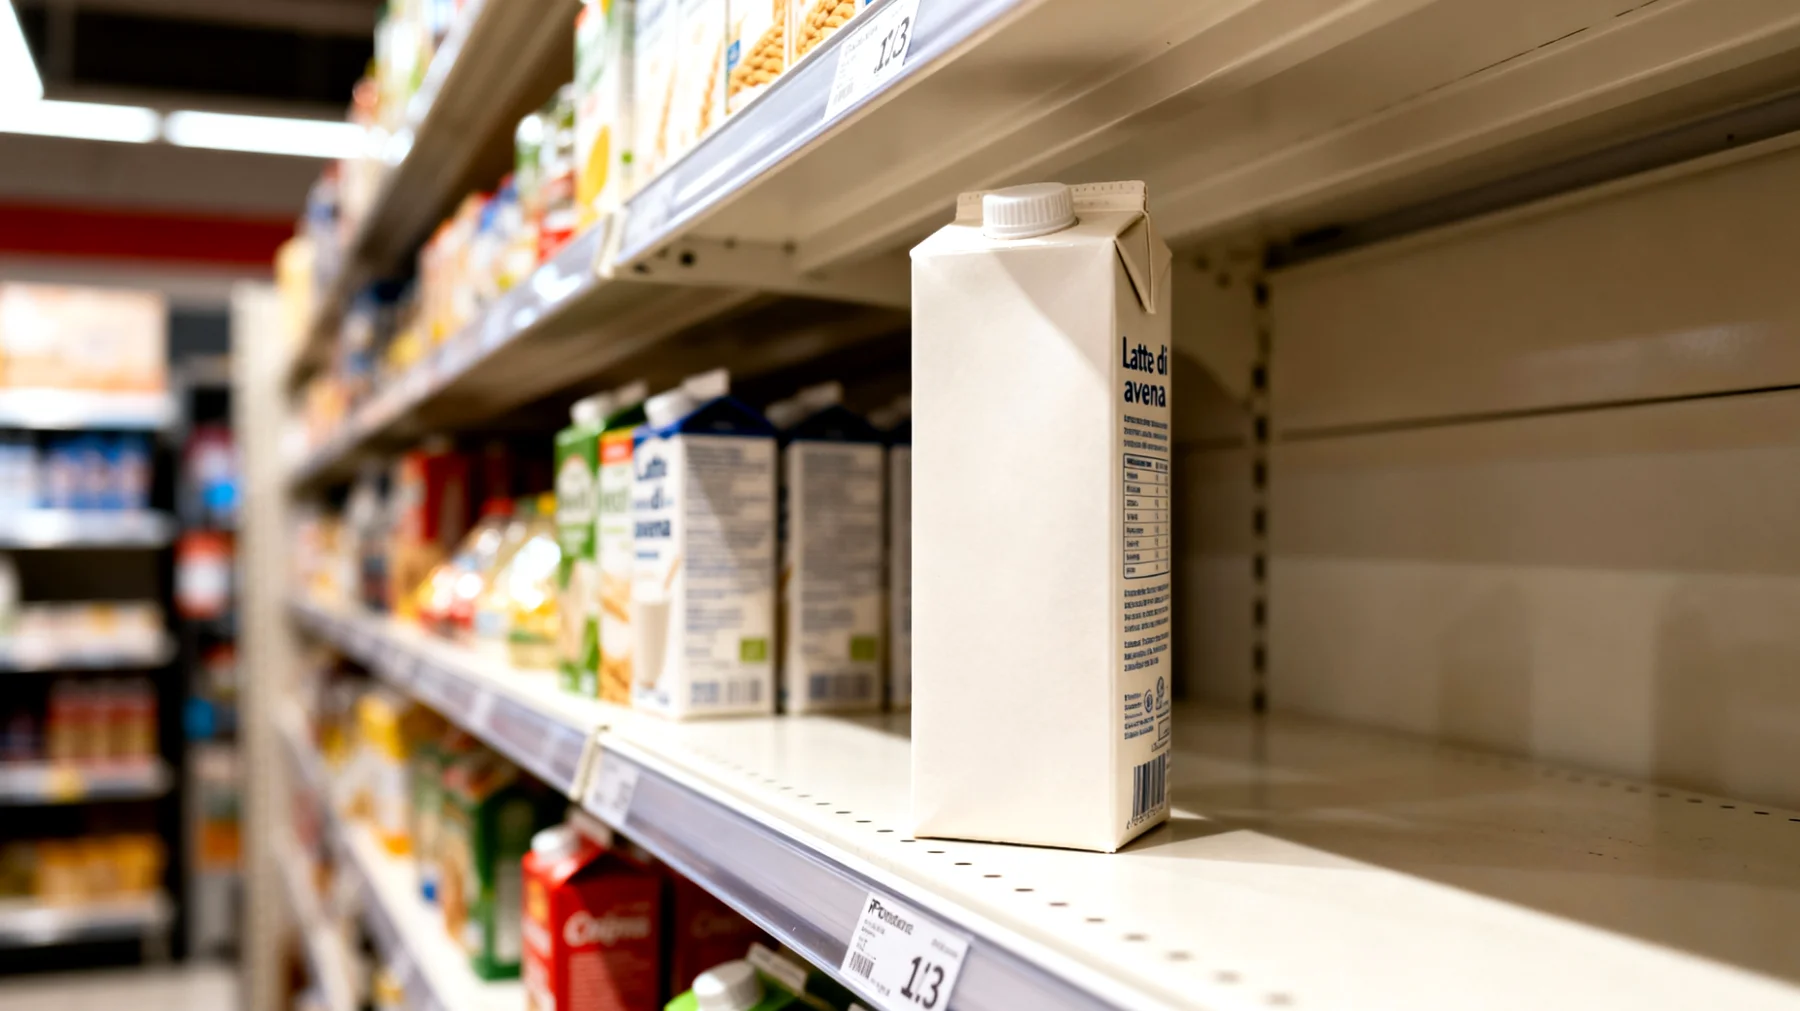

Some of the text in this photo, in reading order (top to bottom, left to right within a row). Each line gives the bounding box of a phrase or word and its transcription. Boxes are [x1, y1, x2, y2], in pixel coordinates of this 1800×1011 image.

[1123, 335, 1168, 376] Latte di
[1124, 380, 1166, 407] avena
